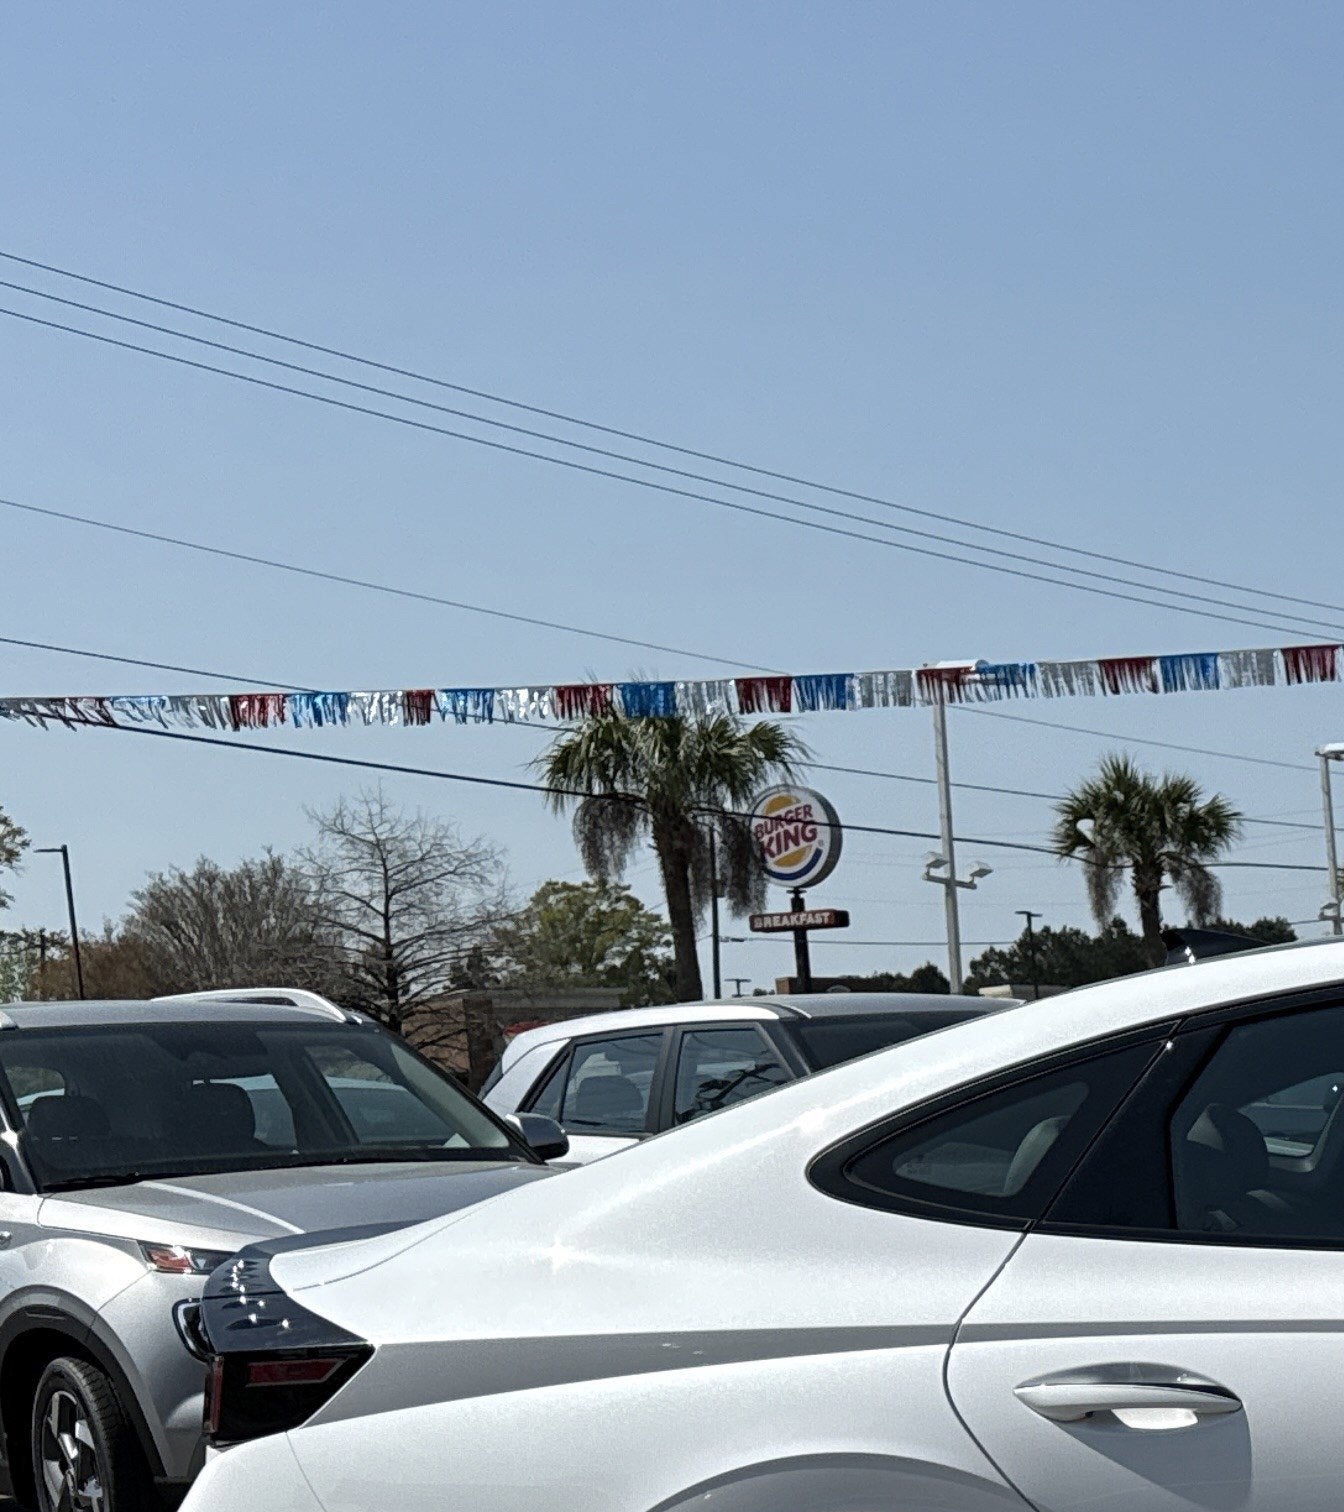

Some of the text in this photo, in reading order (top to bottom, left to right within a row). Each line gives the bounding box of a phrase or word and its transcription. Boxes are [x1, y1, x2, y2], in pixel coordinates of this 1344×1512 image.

[753, 803, 814, 840] BURGER
[760, 823, 818, 859] KING
[753, 912, 830, 928] BREAKFAST
